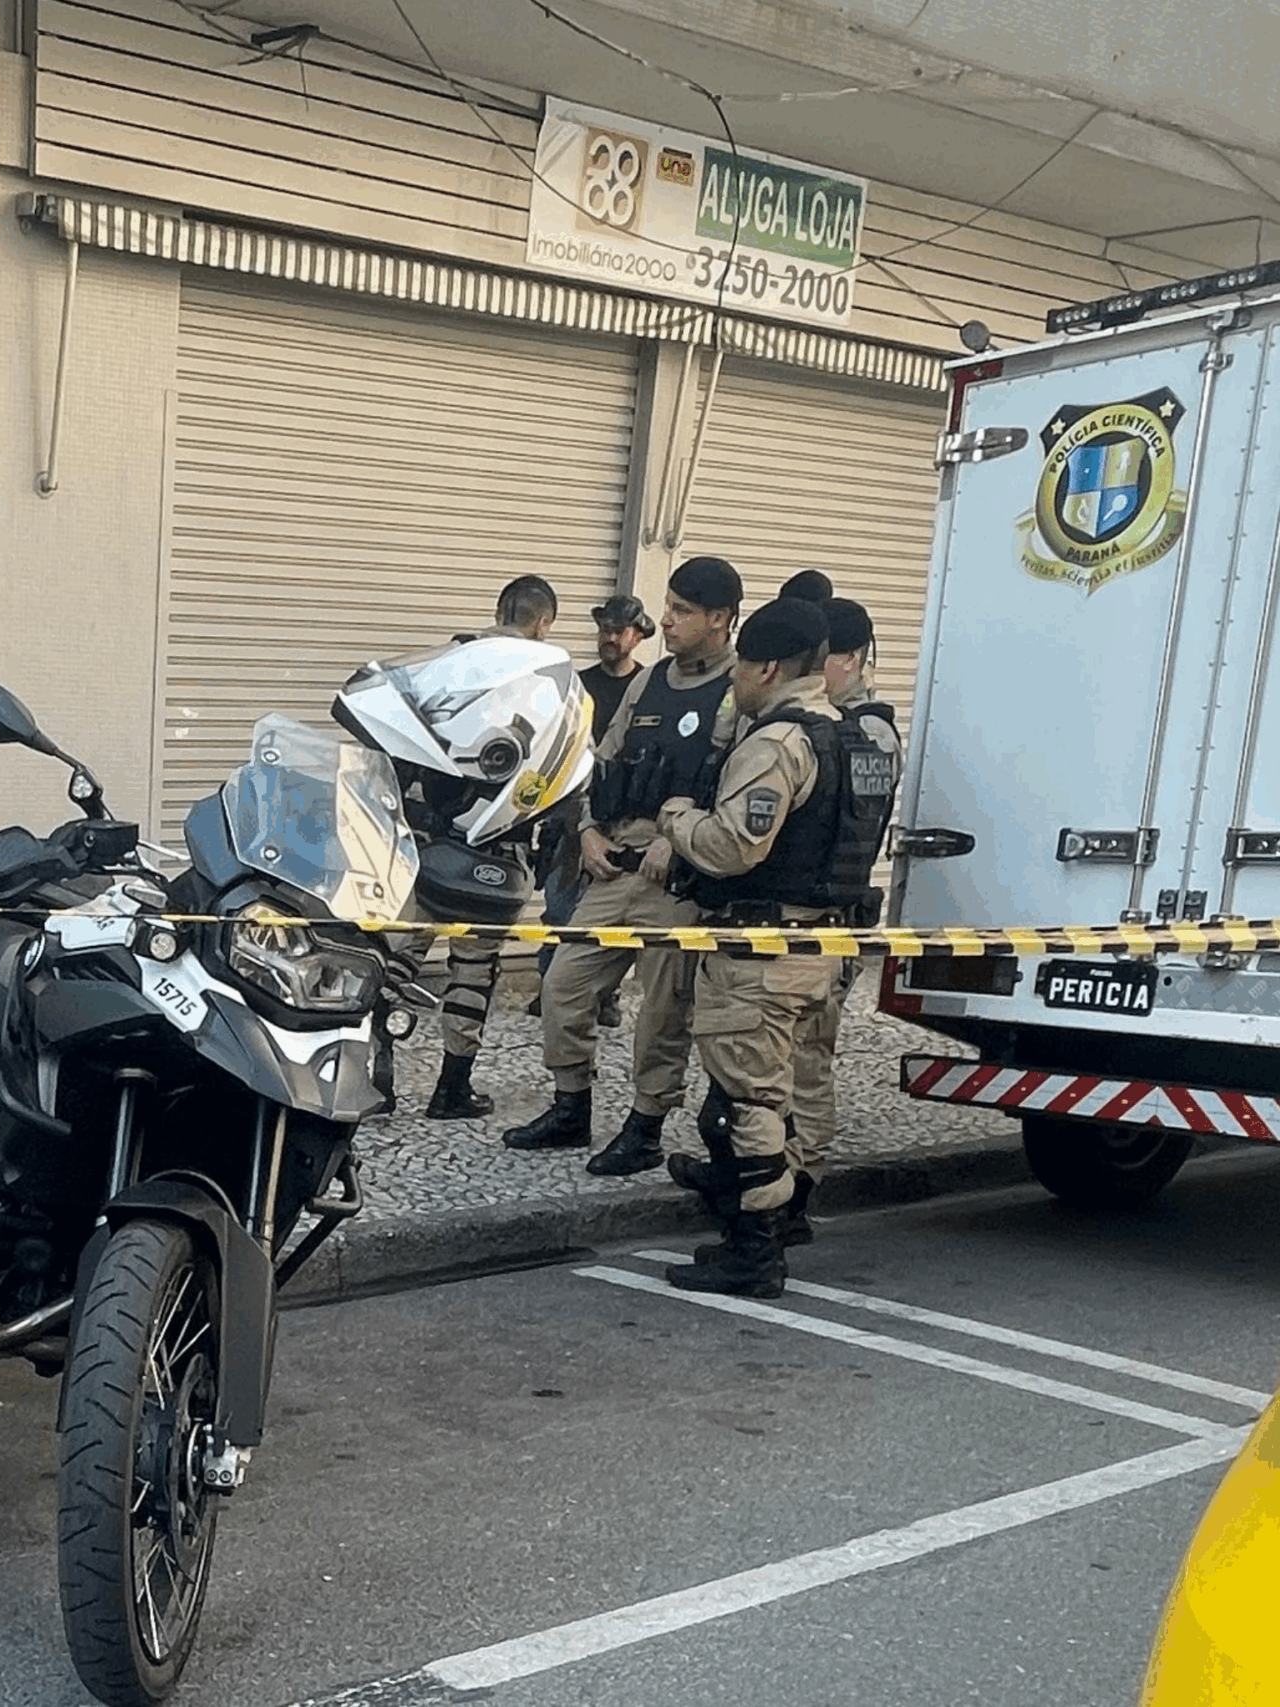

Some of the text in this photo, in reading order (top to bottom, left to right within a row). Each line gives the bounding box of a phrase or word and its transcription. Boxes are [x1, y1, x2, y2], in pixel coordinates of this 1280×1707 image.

[699, 163, 855, 253] ALUGA LOJA
[694, 246, 849, 316] 3250-2000
[153, 977, 198, 1016] 15715
[1049, 977, 1148, 1009] PERICIA
